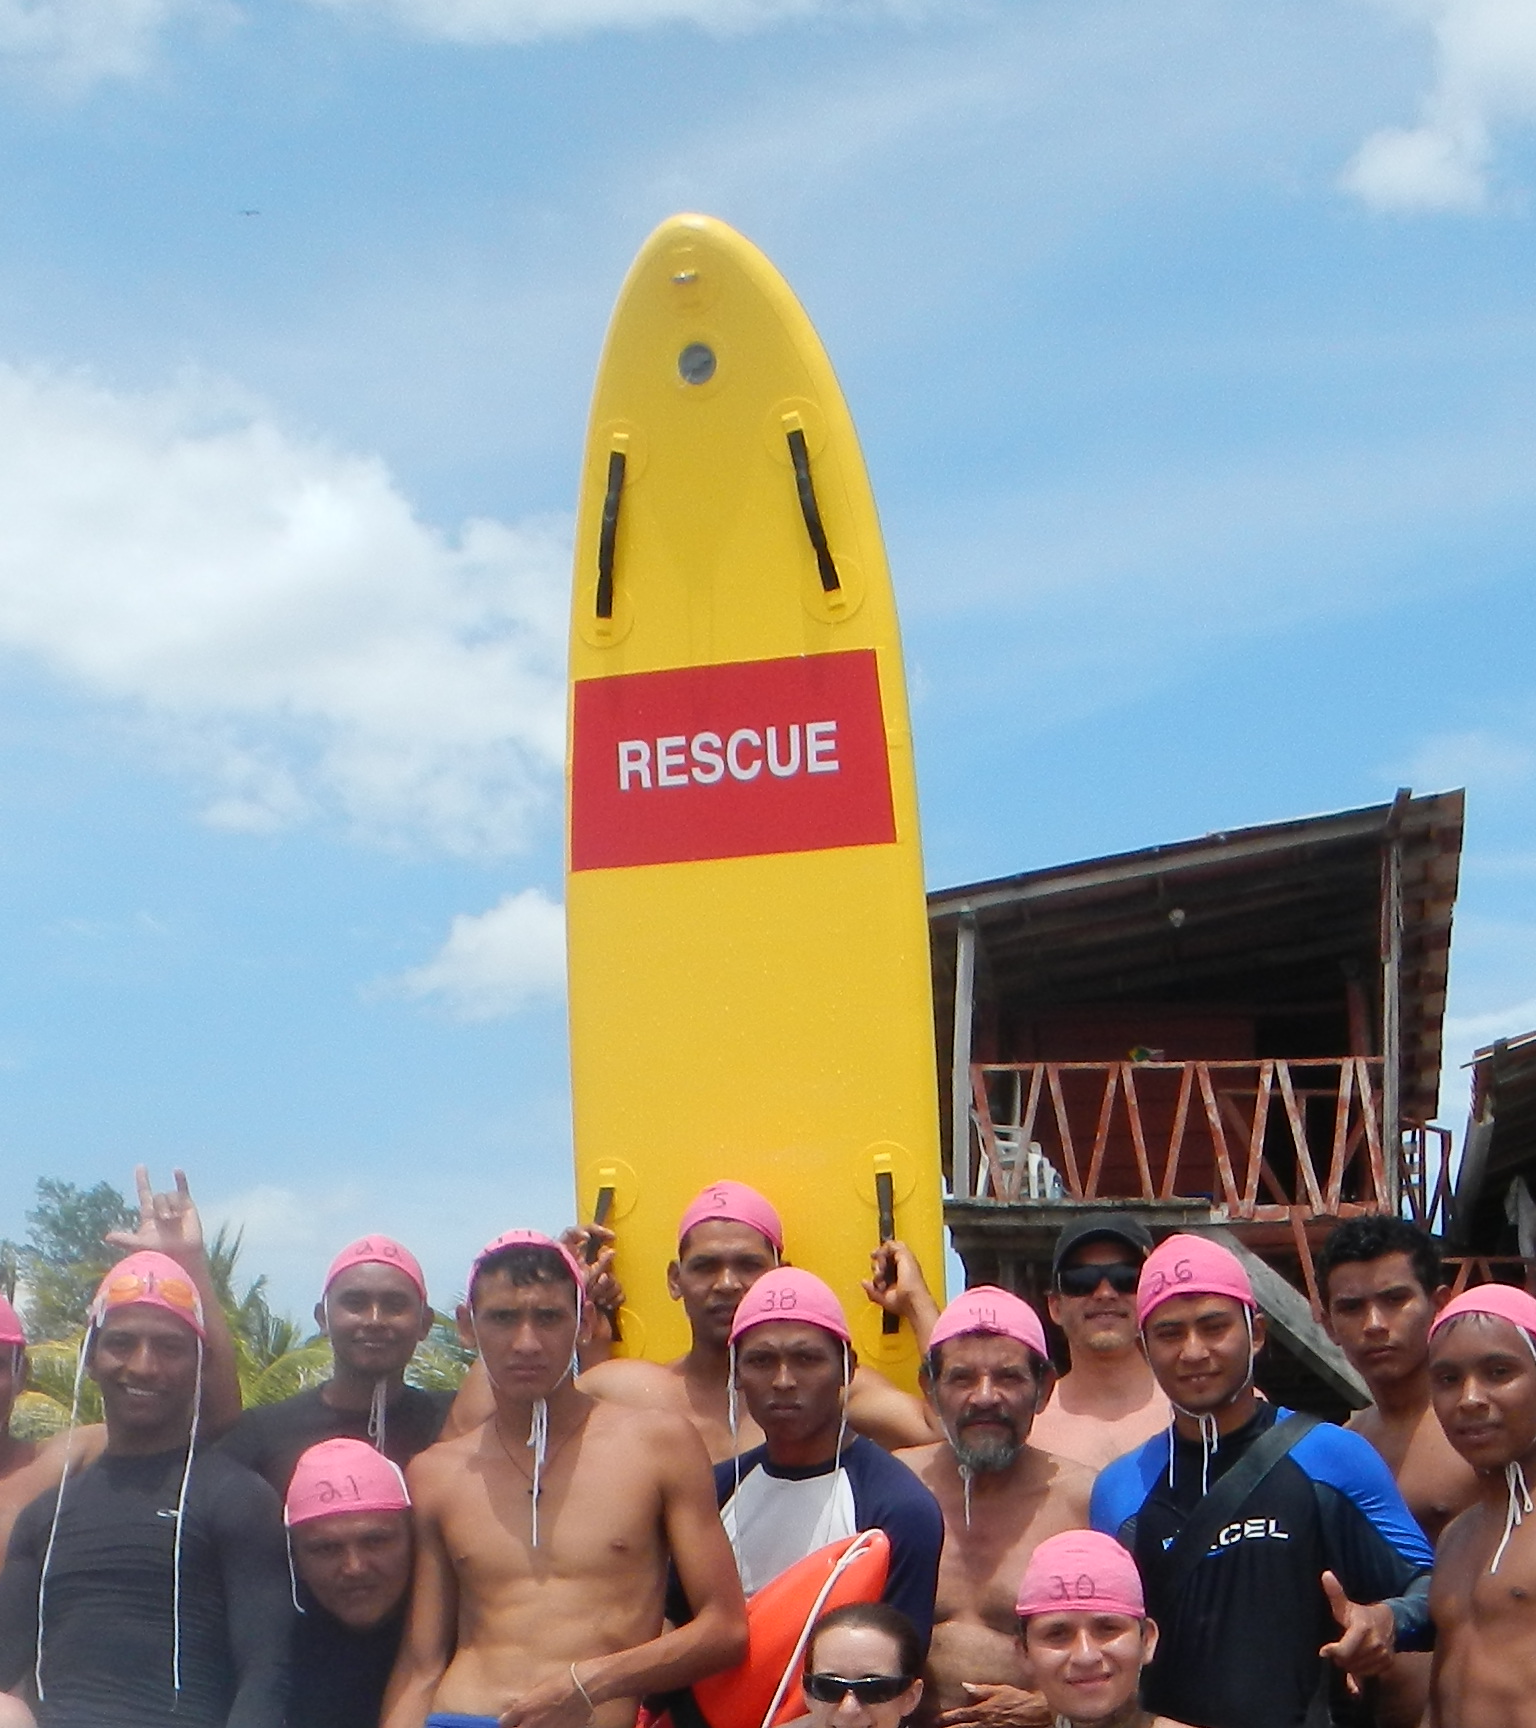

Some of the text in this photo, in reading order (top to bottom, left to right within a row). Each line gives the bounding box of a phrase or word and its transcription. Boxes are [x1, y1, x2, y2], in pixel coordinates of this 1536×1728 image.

[617, 720, 840, 790] RESCUE
[713, 1191, 729, 1209] 5
[1150, 1258, 1194, 1295] 26
[760, 1287, 798, 1313] 38
[968, 1306, 996, 1324] 44
[315, 1474, 362, 1503] 21
